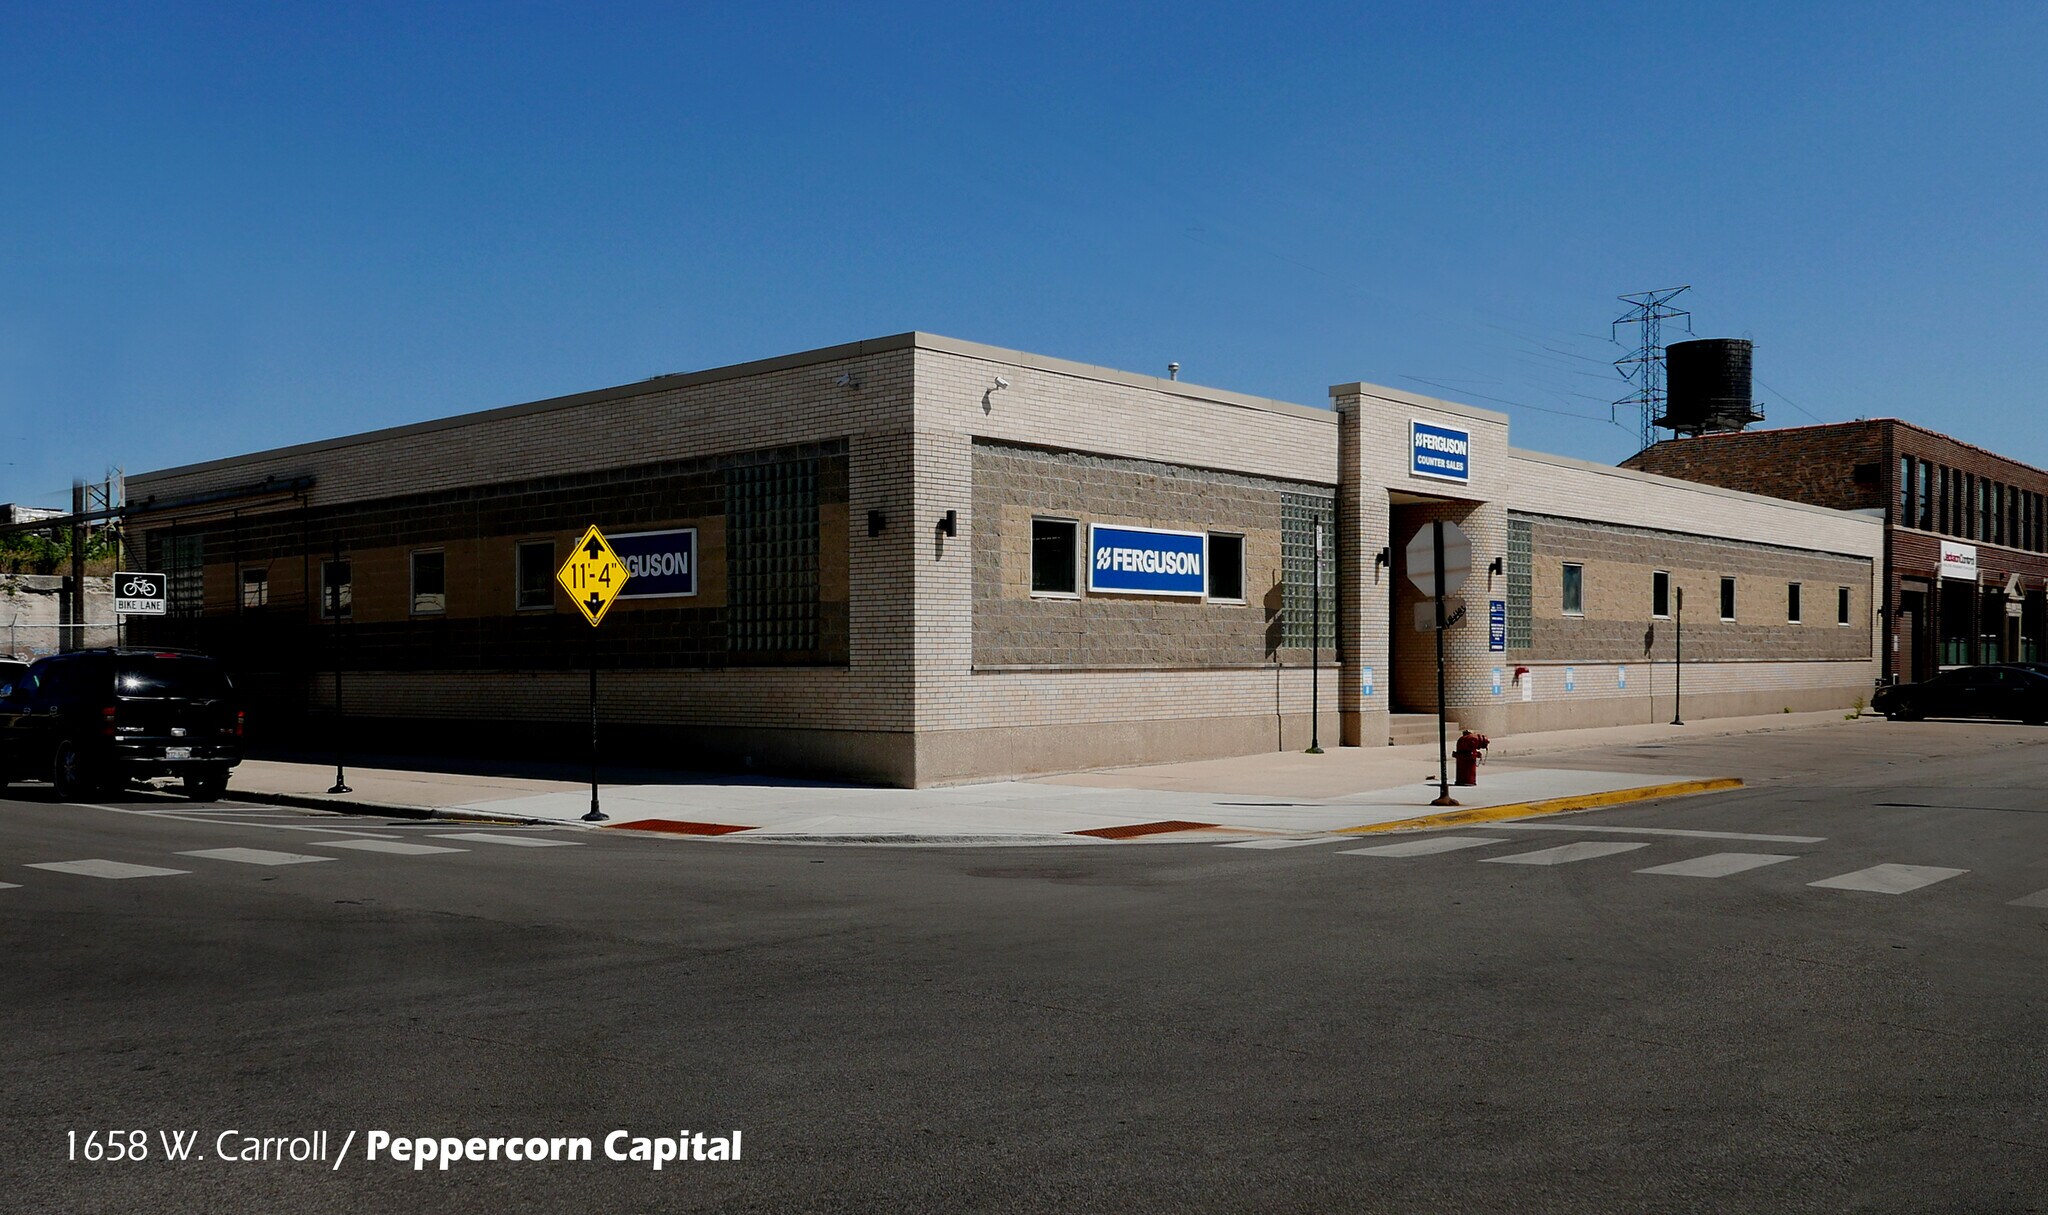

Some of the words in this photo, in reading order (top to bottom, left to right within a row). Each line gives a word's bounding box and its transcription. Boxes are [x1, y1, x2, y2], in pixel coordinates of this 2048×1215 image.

[1422, 433, 1467, 456] FERGUSON
[1417, 454, 1446, 468] COUNTER
[1446, 459, 1464, 471] SALES
[616, 551, 689, 578] GUSON
[1112, 547, 1200, 576] FERGUSON
[118, 600, 137, 610] BIKE
[140, 601, 162, 610] LANE
